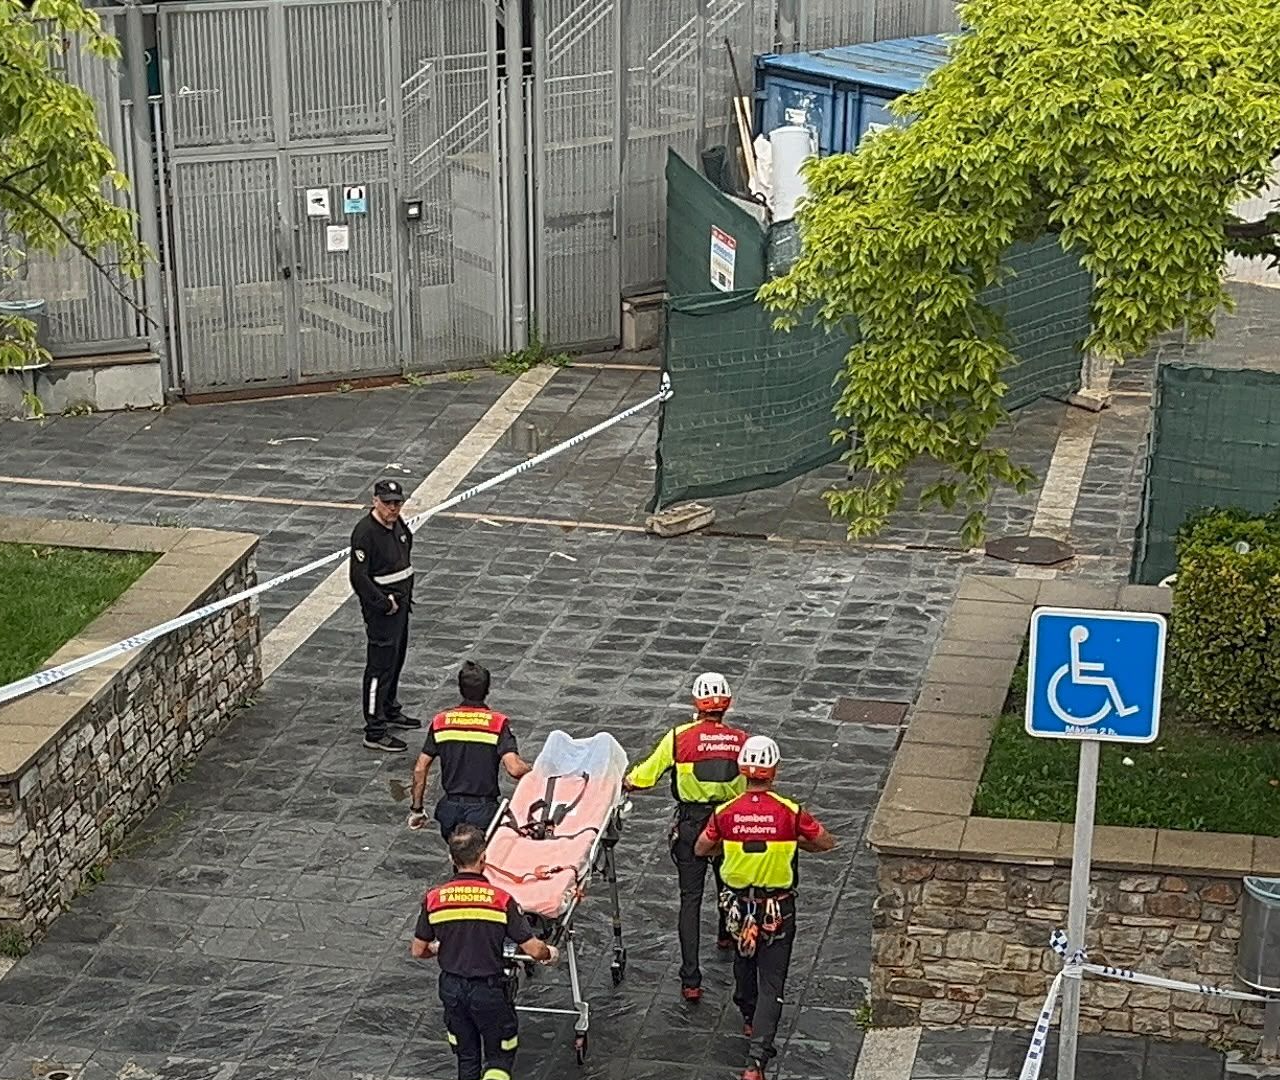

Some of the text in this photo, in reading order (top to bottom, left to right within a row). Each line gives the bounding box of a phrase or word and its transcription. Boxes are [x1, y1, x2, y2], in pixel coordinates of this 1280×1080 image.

[700, 733, 738, 742] Bombers
[733, 814, 774, 823] Bombers
[732, 825, 777, 834] d'Andorra
